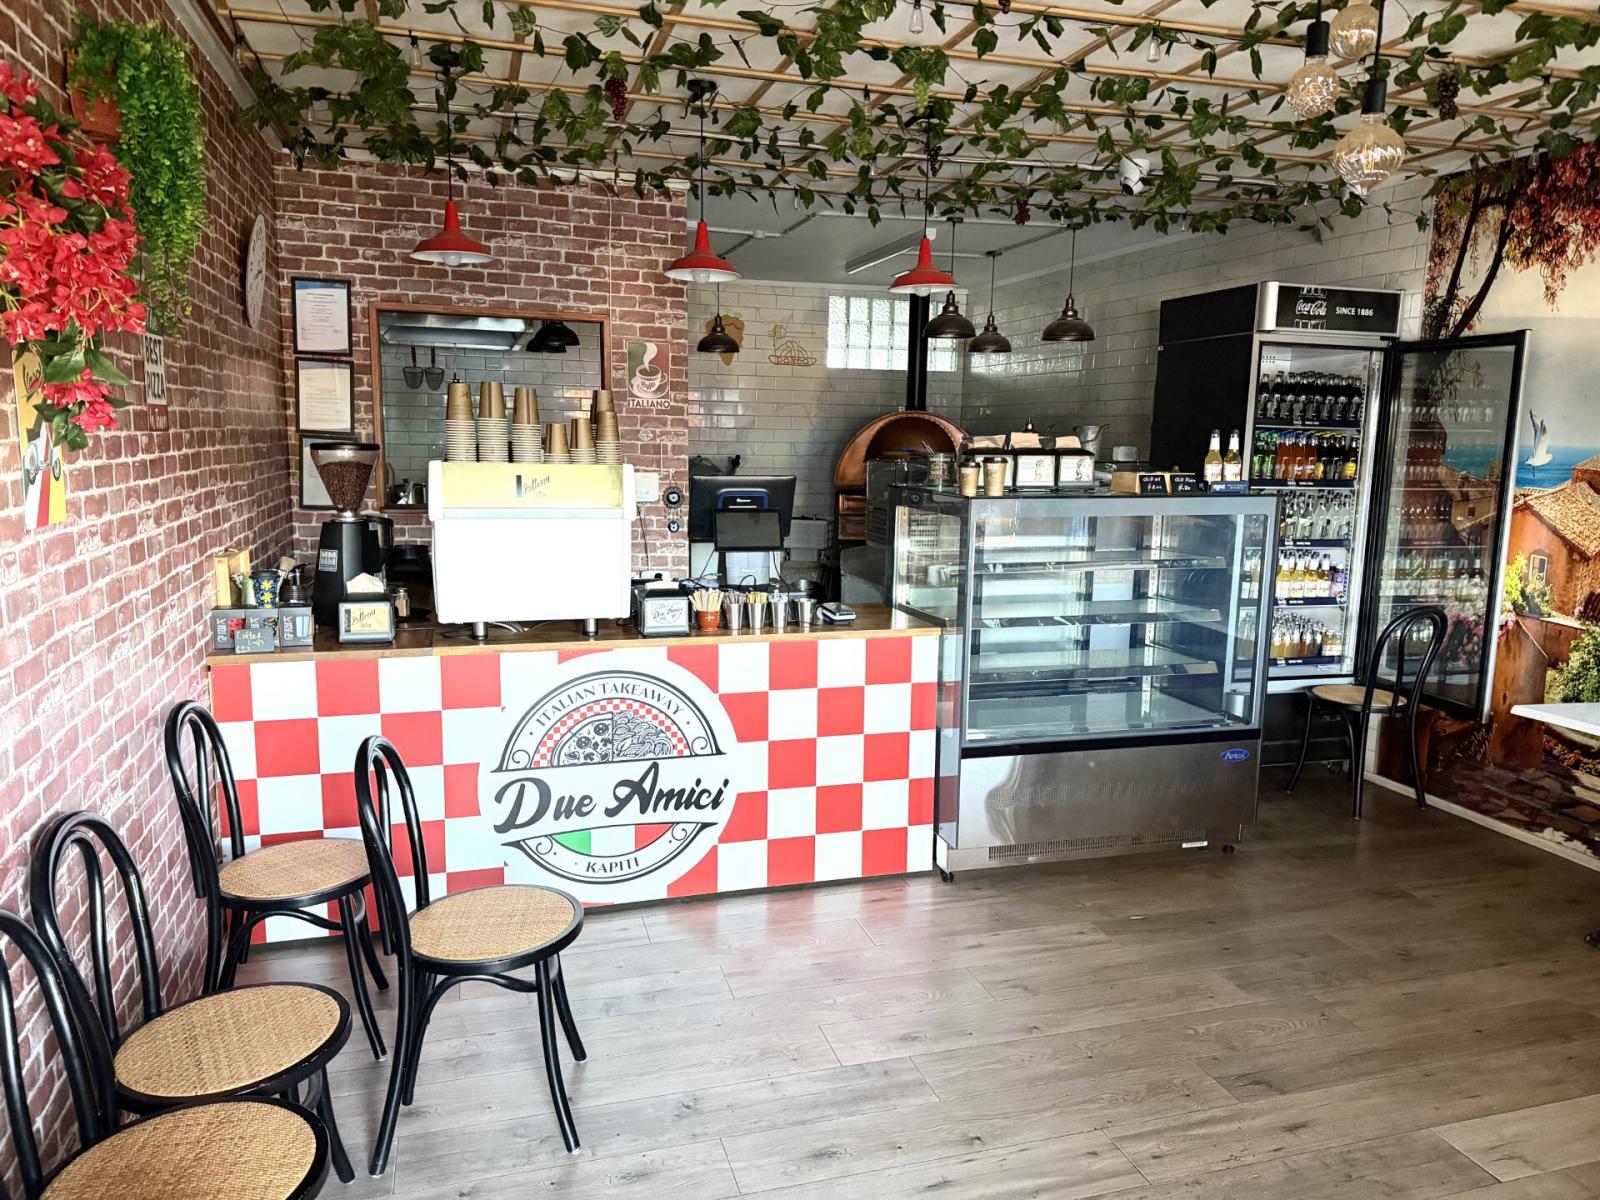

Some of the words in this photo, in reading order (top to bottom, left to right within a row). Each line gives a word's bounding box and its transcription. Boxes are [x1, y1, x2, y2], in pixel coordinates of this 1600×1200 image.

[1336, 307, 1356, 316] SINCE
[1357, 308, 1374, 316] 1886
[145, 334, 163, 366] BEST
[146, 370, 166, 400] PIZZA
[628, 399, 671, 409] ITALIANO
[536, 685, 596, 726] ITALIAN
[599, 682, 685, 715] TAKEAWAY
[493, 777, 597, 834] Due
[604, 761, 730, 818] Amici
[586, 856, 640, 874] KAPITI
